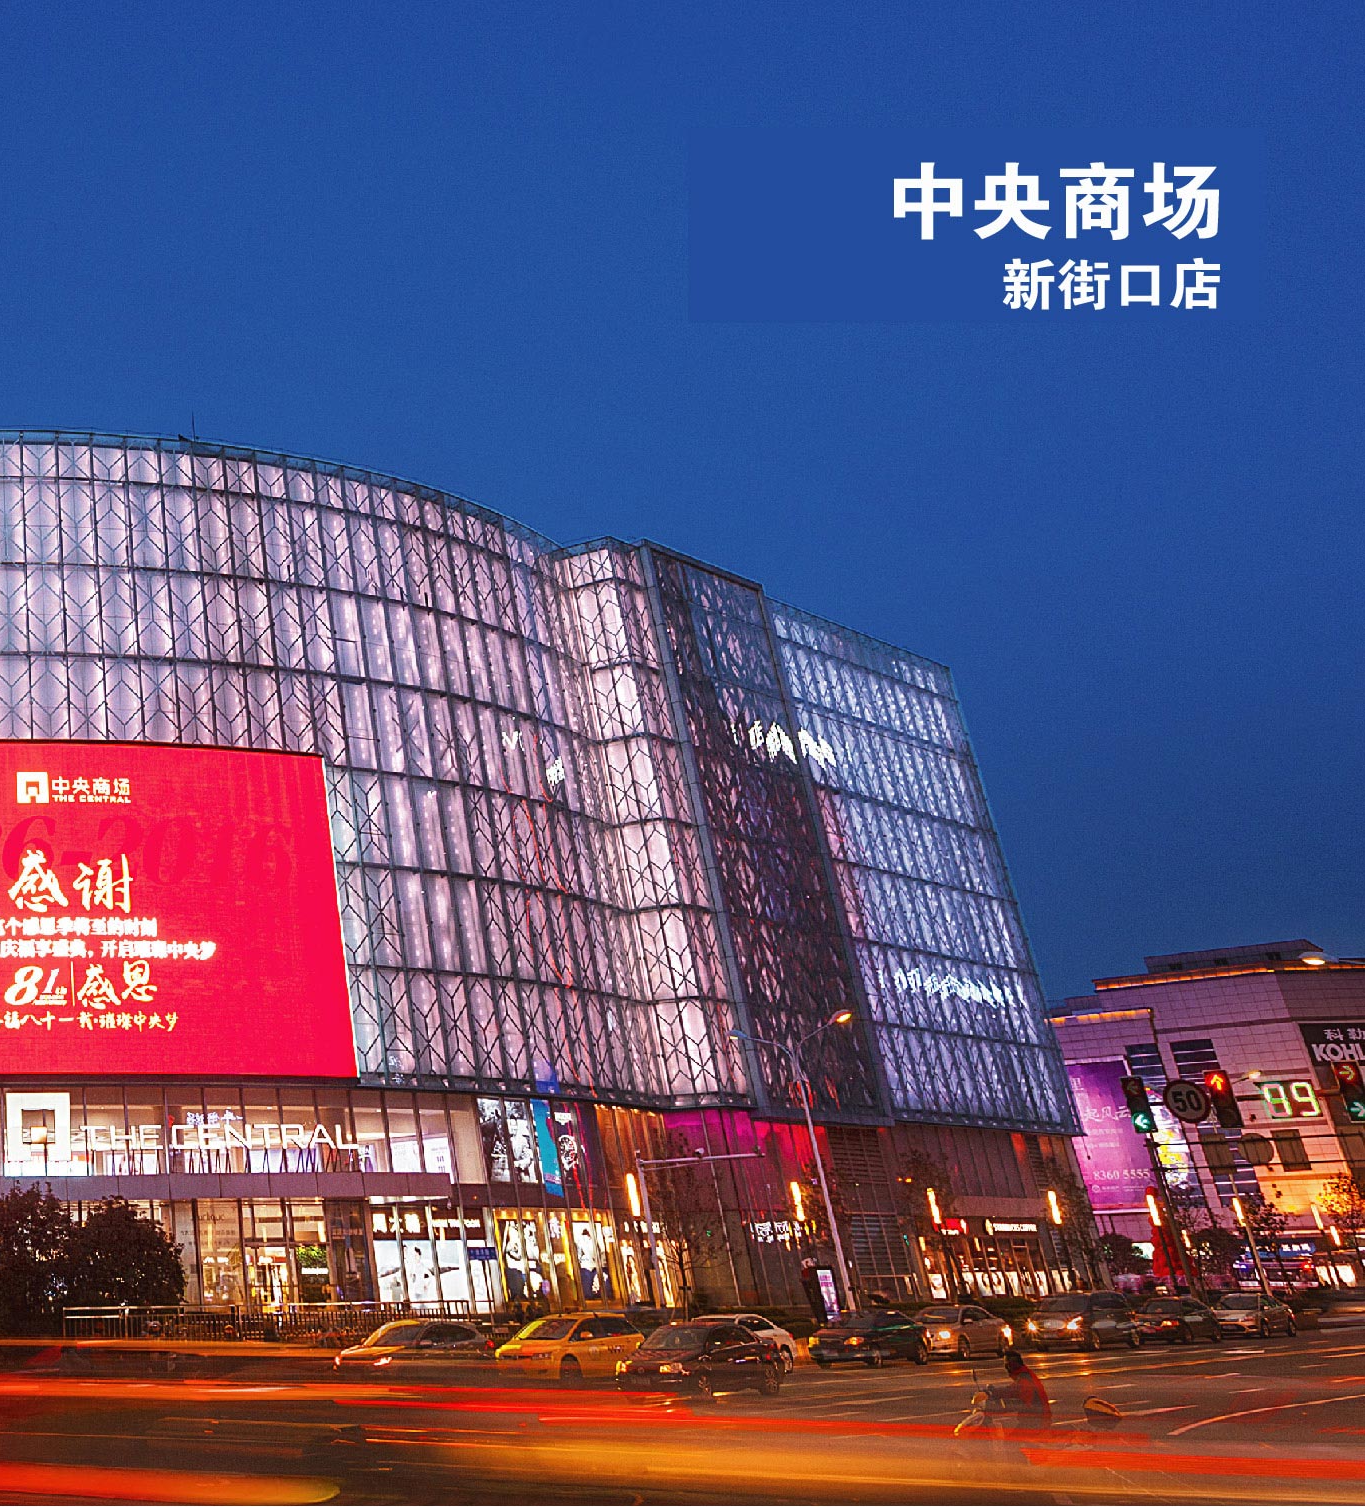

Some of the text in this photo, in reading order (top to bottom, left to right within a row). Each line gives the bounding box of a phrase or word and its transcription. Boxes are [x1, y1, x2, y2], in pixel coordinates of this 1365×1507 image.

[51, 776, 130, 795] 中央商场
[51, 794, 132, 804] THE CENTRAL
[8, 849, 134, 912] 感谢
[77, 960, 158, 1009] 感恩
[1171, 1089, 1202, 1113] 50
[80, 1124, 360, 1150] THE CENTRAL
[1093, 1168, 1151, 1180] 8360 5555
